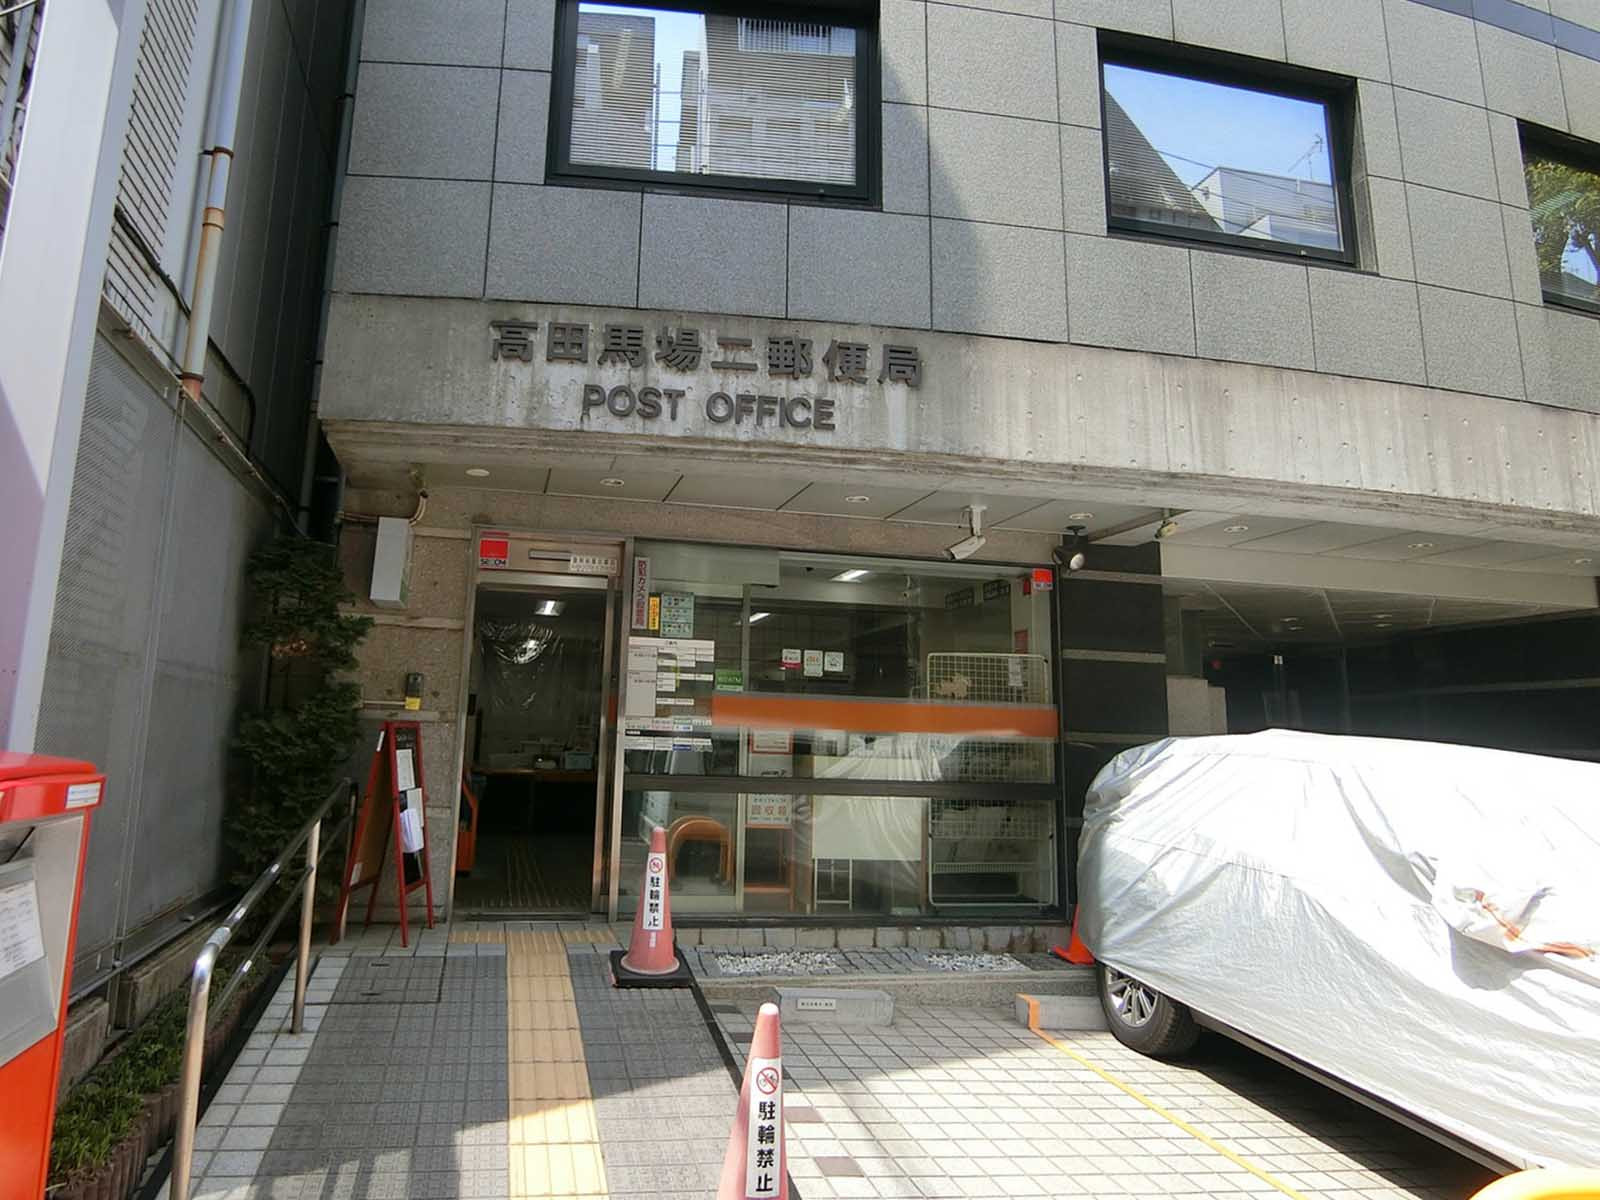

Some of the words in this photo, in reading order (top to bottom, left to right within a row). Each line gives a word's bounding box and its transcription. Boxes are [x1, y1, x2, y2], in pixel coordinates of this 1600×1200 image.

[490, 318, 923, 388] 高田馬場二郵便局
[582, 384, 685, 421] POST
[706, 391, 836, 431] OFFICE
[648, 876, 661, 927] 駐輪禁止
[756, 1100, 776, 1193] 駐輪禁止
